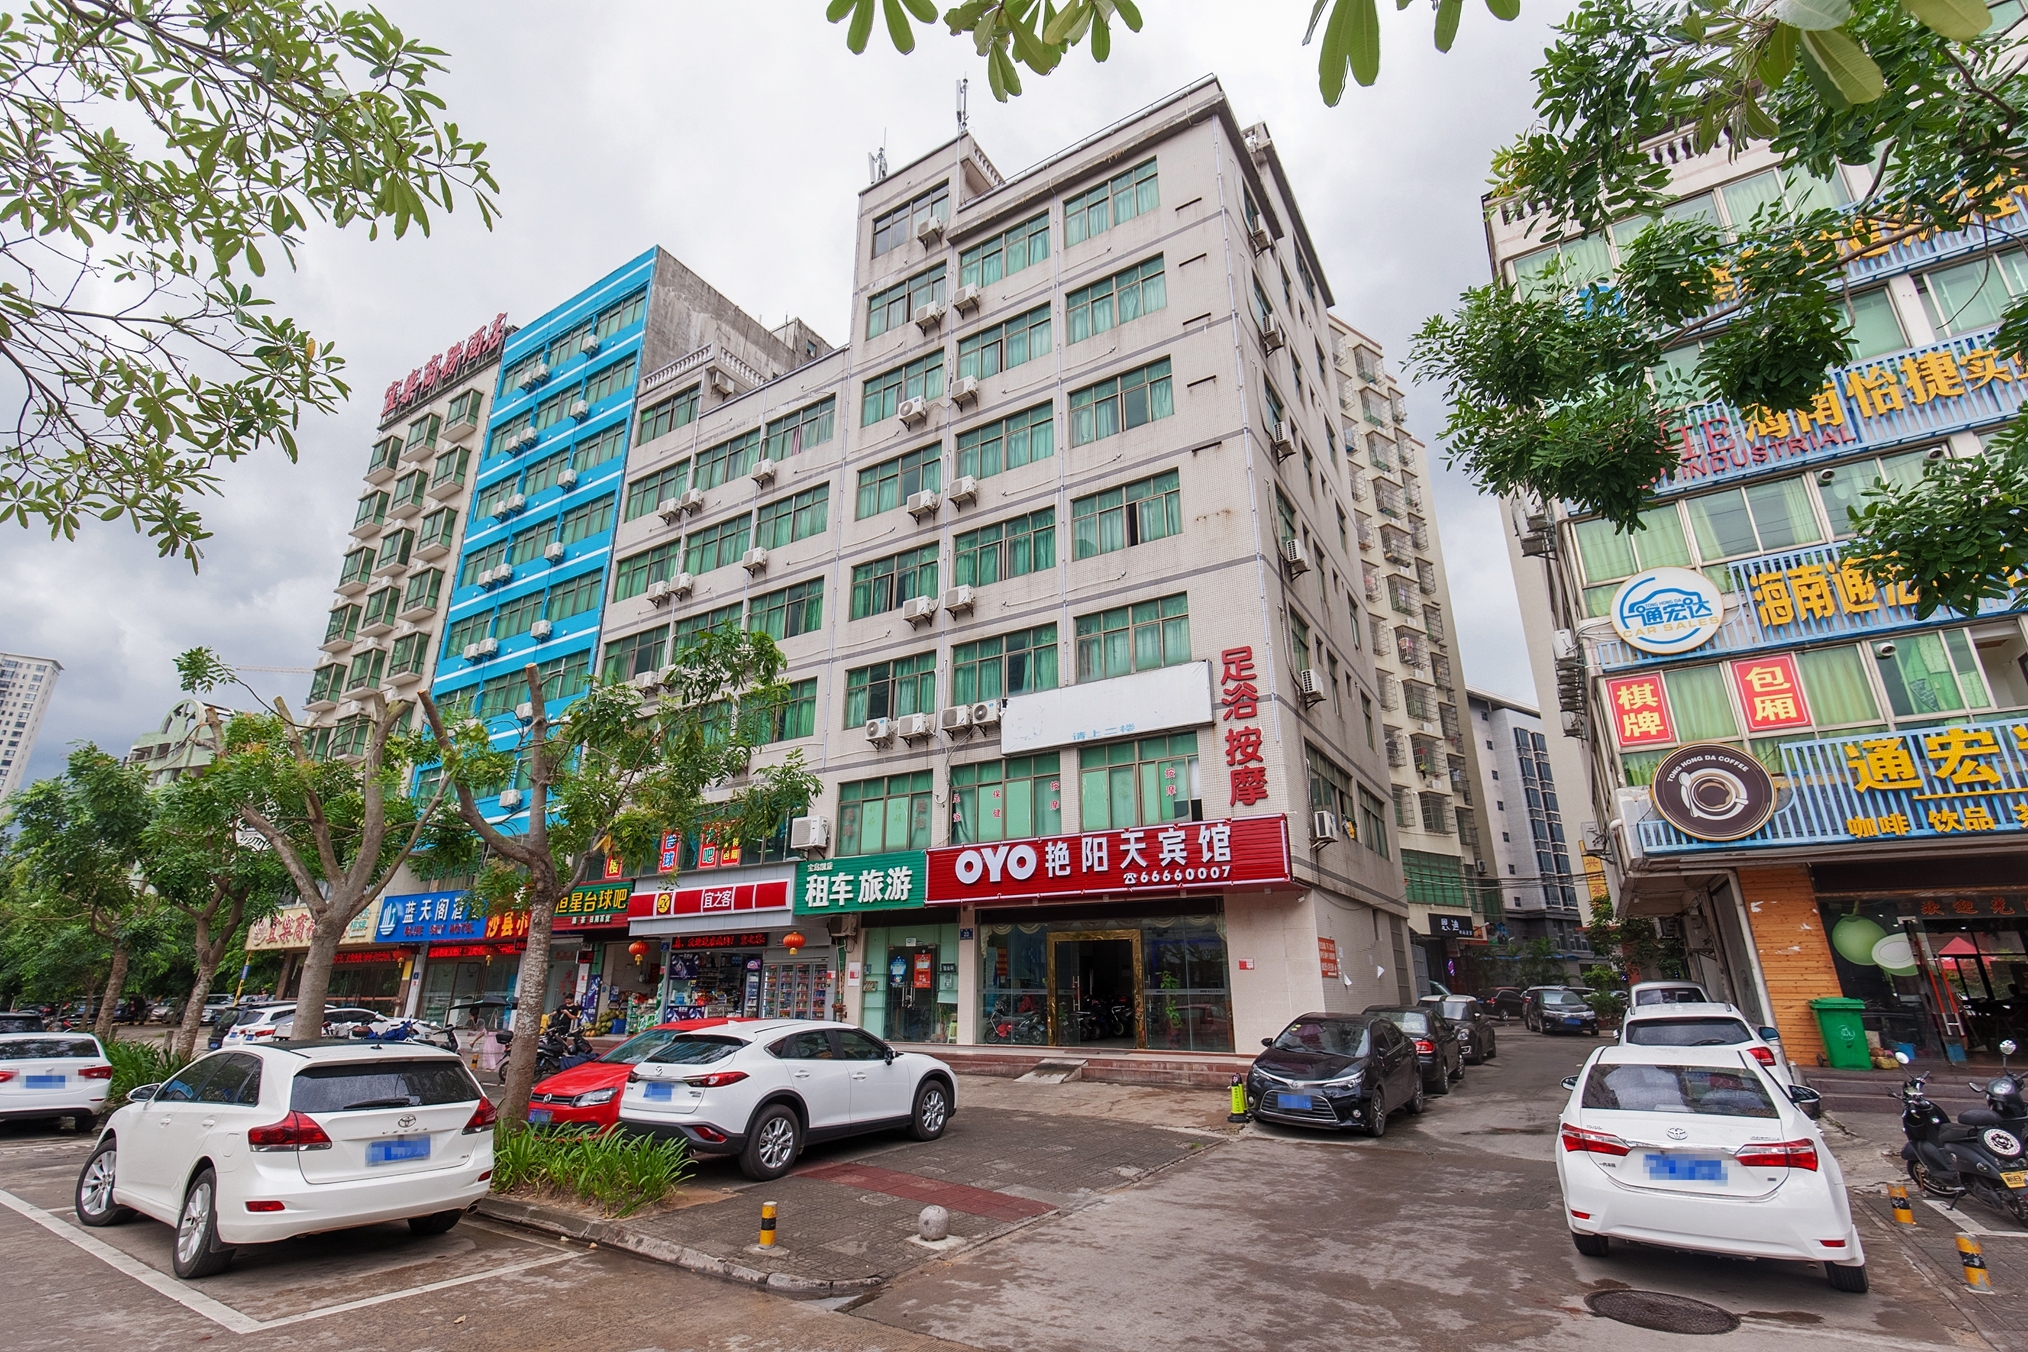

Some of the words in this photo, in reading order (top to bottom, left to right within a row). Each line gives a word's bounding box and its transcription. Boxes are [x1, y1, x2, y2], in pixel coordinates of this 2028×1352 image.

[1682, 426, 1857, 480] INDUSTRIAL
[1623, 626, 1657, 638] CAR
[1663, 616, 1720, 632] SALES
[1635, 597, 1713, 627] 通宏达
[1744, 666, 1799, 722] 包厢
[1220, 646, 1268, 806] 足浴按摩
[1617, 683, 1664, 738] 棋牌
[1071, 723, 1136, 741] 请上二楼
[1667, 765, 1682, 782] TONG
[1680, 755, 1703, 768] HONG
[1718, 755, 1750, 772] COFFEE
[1844, 725, 2028, 793] 通宏
[1846, 813, 1911, 839] 咖啡
[1928, 806, 1997, 833] 饮品
[955, 845, 1037, 885] OYO
[1045, 823, 1232, 878] 艳阳天宾馆
[805, 866, 912, 907] 租车旅游
[1140, 865, 1231, 883] 66660007
[703, 890, 732, 909] 宜之客
[1921, 896, 2028, 916] 欢迎光
[430, 924, 446, 935] SKY
